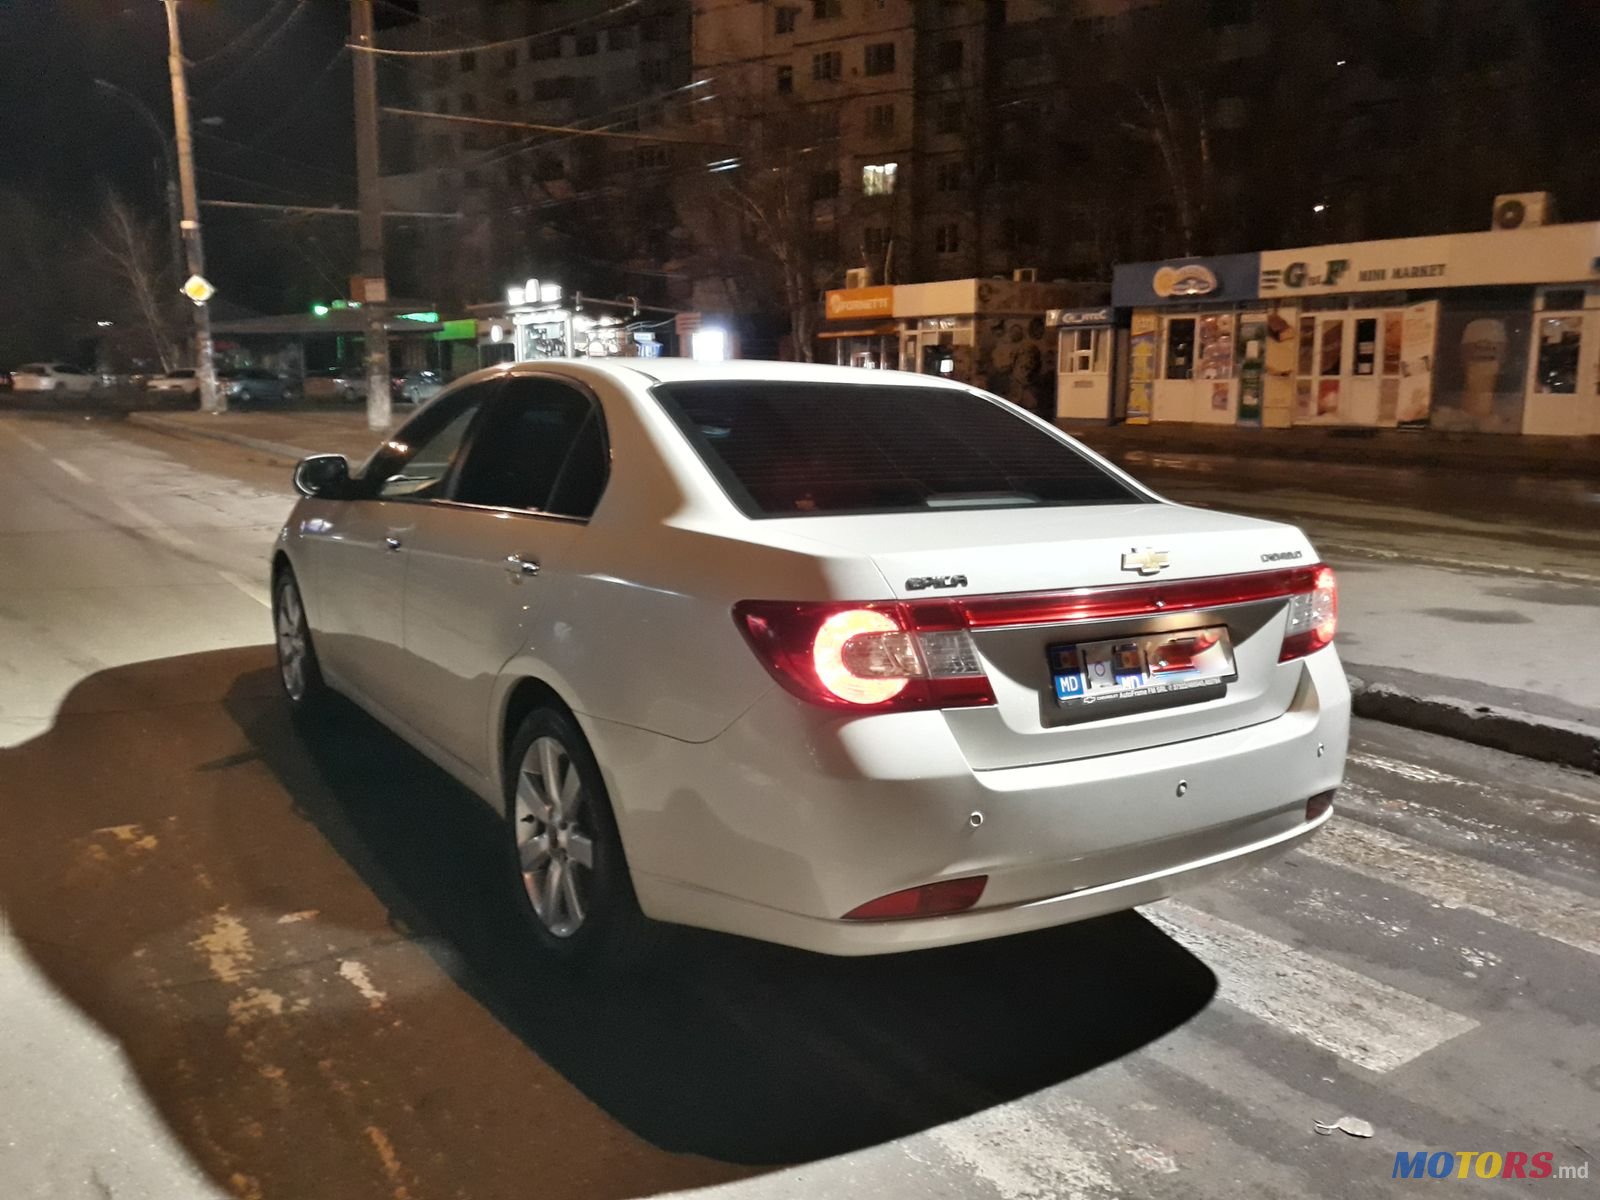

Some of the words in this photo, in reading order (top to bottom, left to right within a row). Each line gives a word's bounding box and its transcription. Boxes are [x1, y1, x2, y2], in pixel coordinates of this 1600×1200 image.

[1359, 269, 1386, 282] MINI
[1391, 263, 1446, 280] MARKET
[1059, 675, 1080, 694] MD
